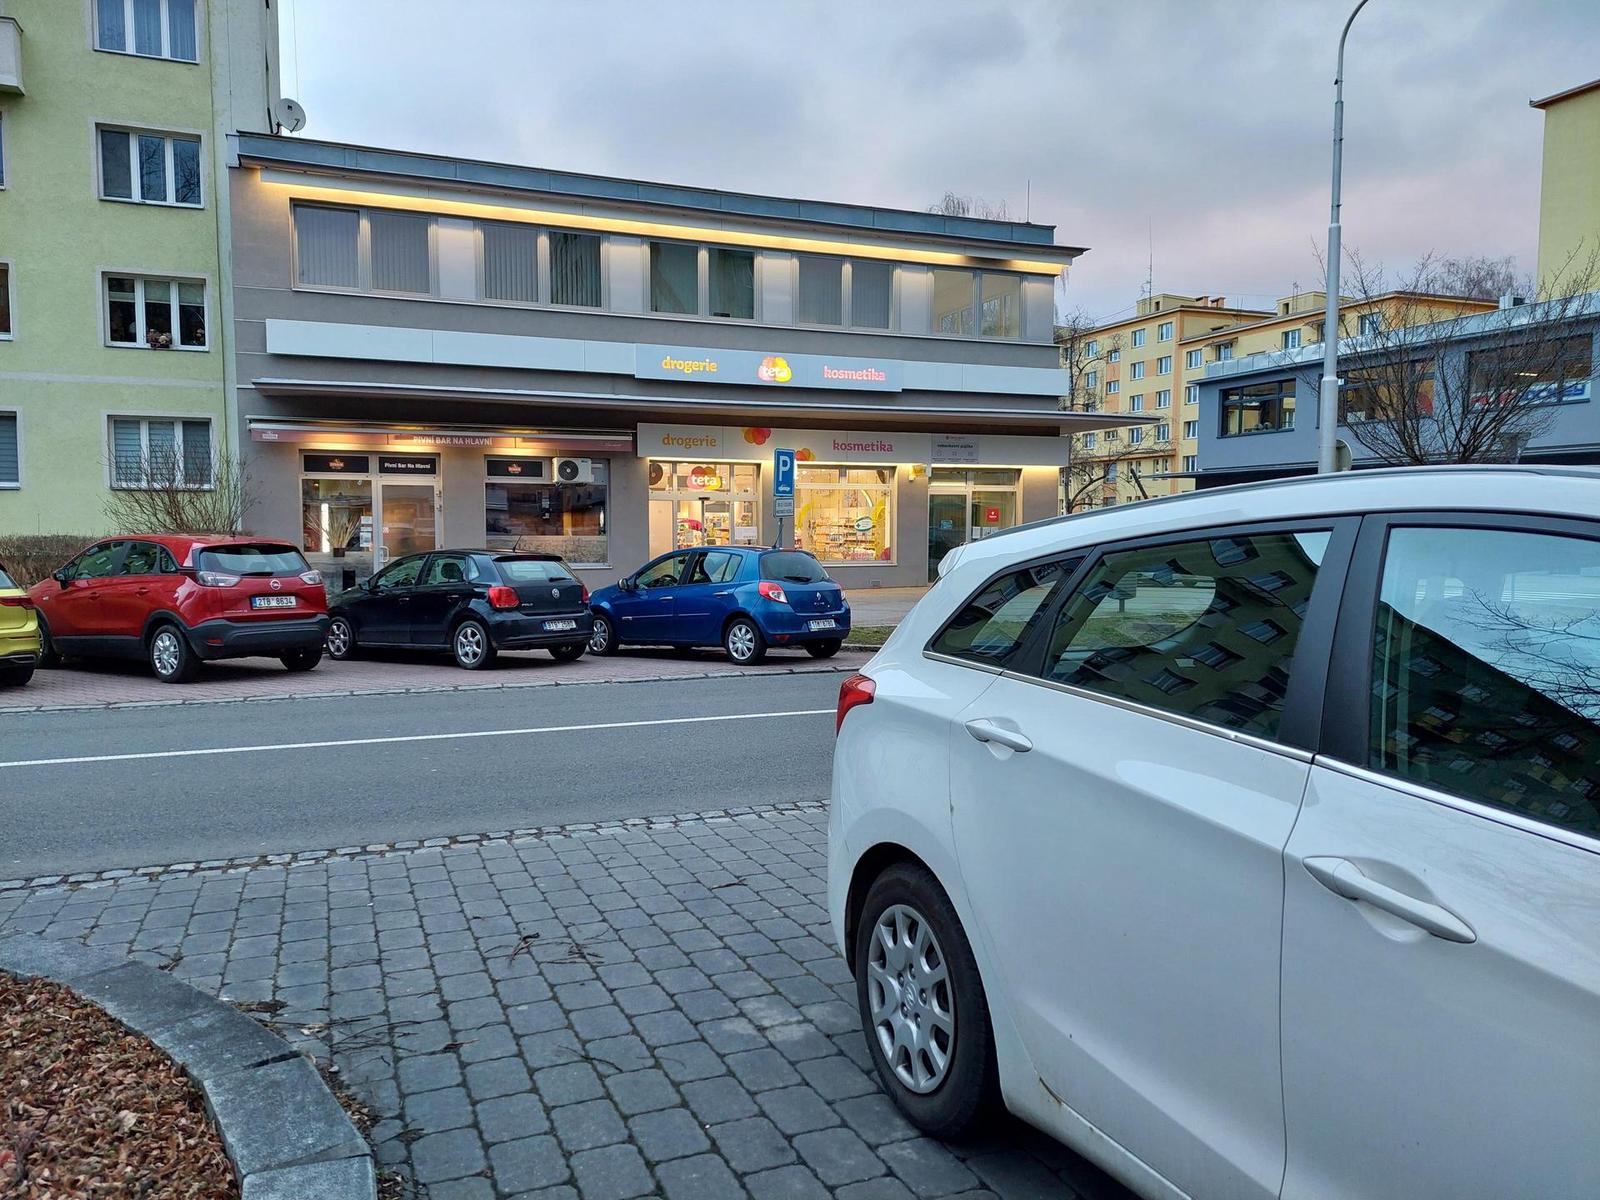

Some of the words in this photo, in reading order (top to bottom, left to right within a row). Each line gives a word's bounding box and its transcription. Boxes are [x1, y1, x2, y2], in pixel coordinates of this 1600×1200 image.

[661, 356, 718, 374] drogerie
[762, 364, 788, 378] teta
[823, 365, 886, 382] kosmetika
[413, 435, 435, 444] PIVNÍ
[436, 436, 452, 445] BAR
[452, 437, 464, 445] NA
[465, 437, 493, 446] HLAVNÍ
[661, 432, 717, 448] drogerie
[832, 439, 894, 453] kosmetika
[778, 455, 791, 482] P
[690, 473, 717, 486] teta
